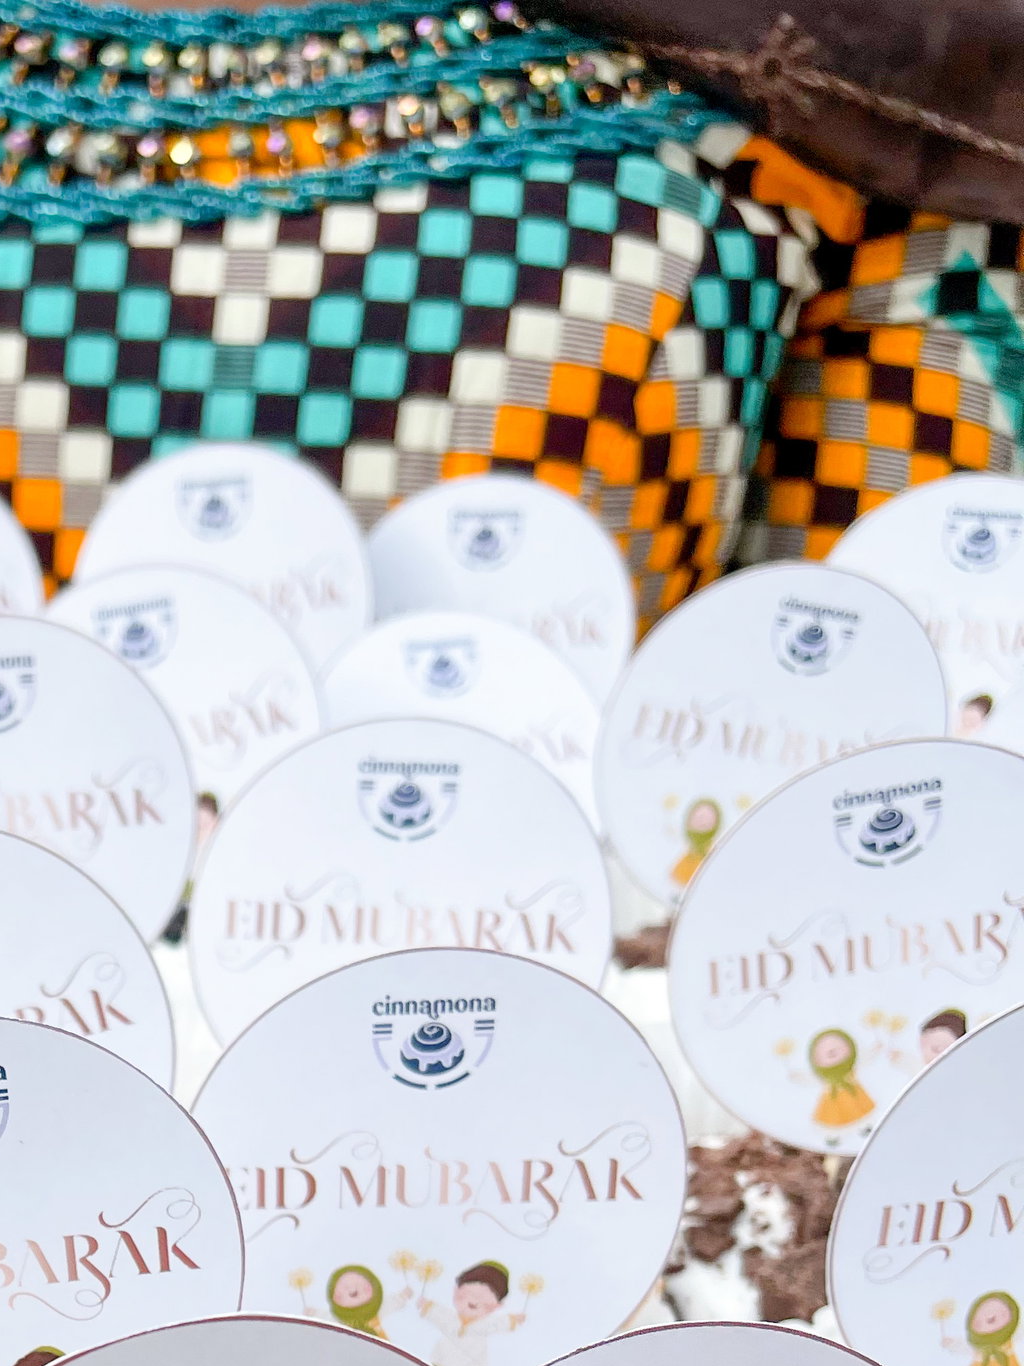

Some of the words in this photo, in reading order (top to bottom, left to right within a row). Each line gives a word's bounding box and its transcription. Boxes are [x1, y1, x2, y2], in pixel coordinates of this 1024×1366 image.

[359, 758, 462, 780] cinnamona
[831, 775, 943, 812] cinnamona
[217, 897, 306, 973] EID
[321, 880, 584, 954] MUBARAK
[705, 946, 793, 1029] EID
[812, 890, 1024, 987] MUBAR
[371, 994, 497, 1021] cinnamona
[338, 1120, 652, 1242] MUBARAK
[866, 1199, 973, 1284] EID
